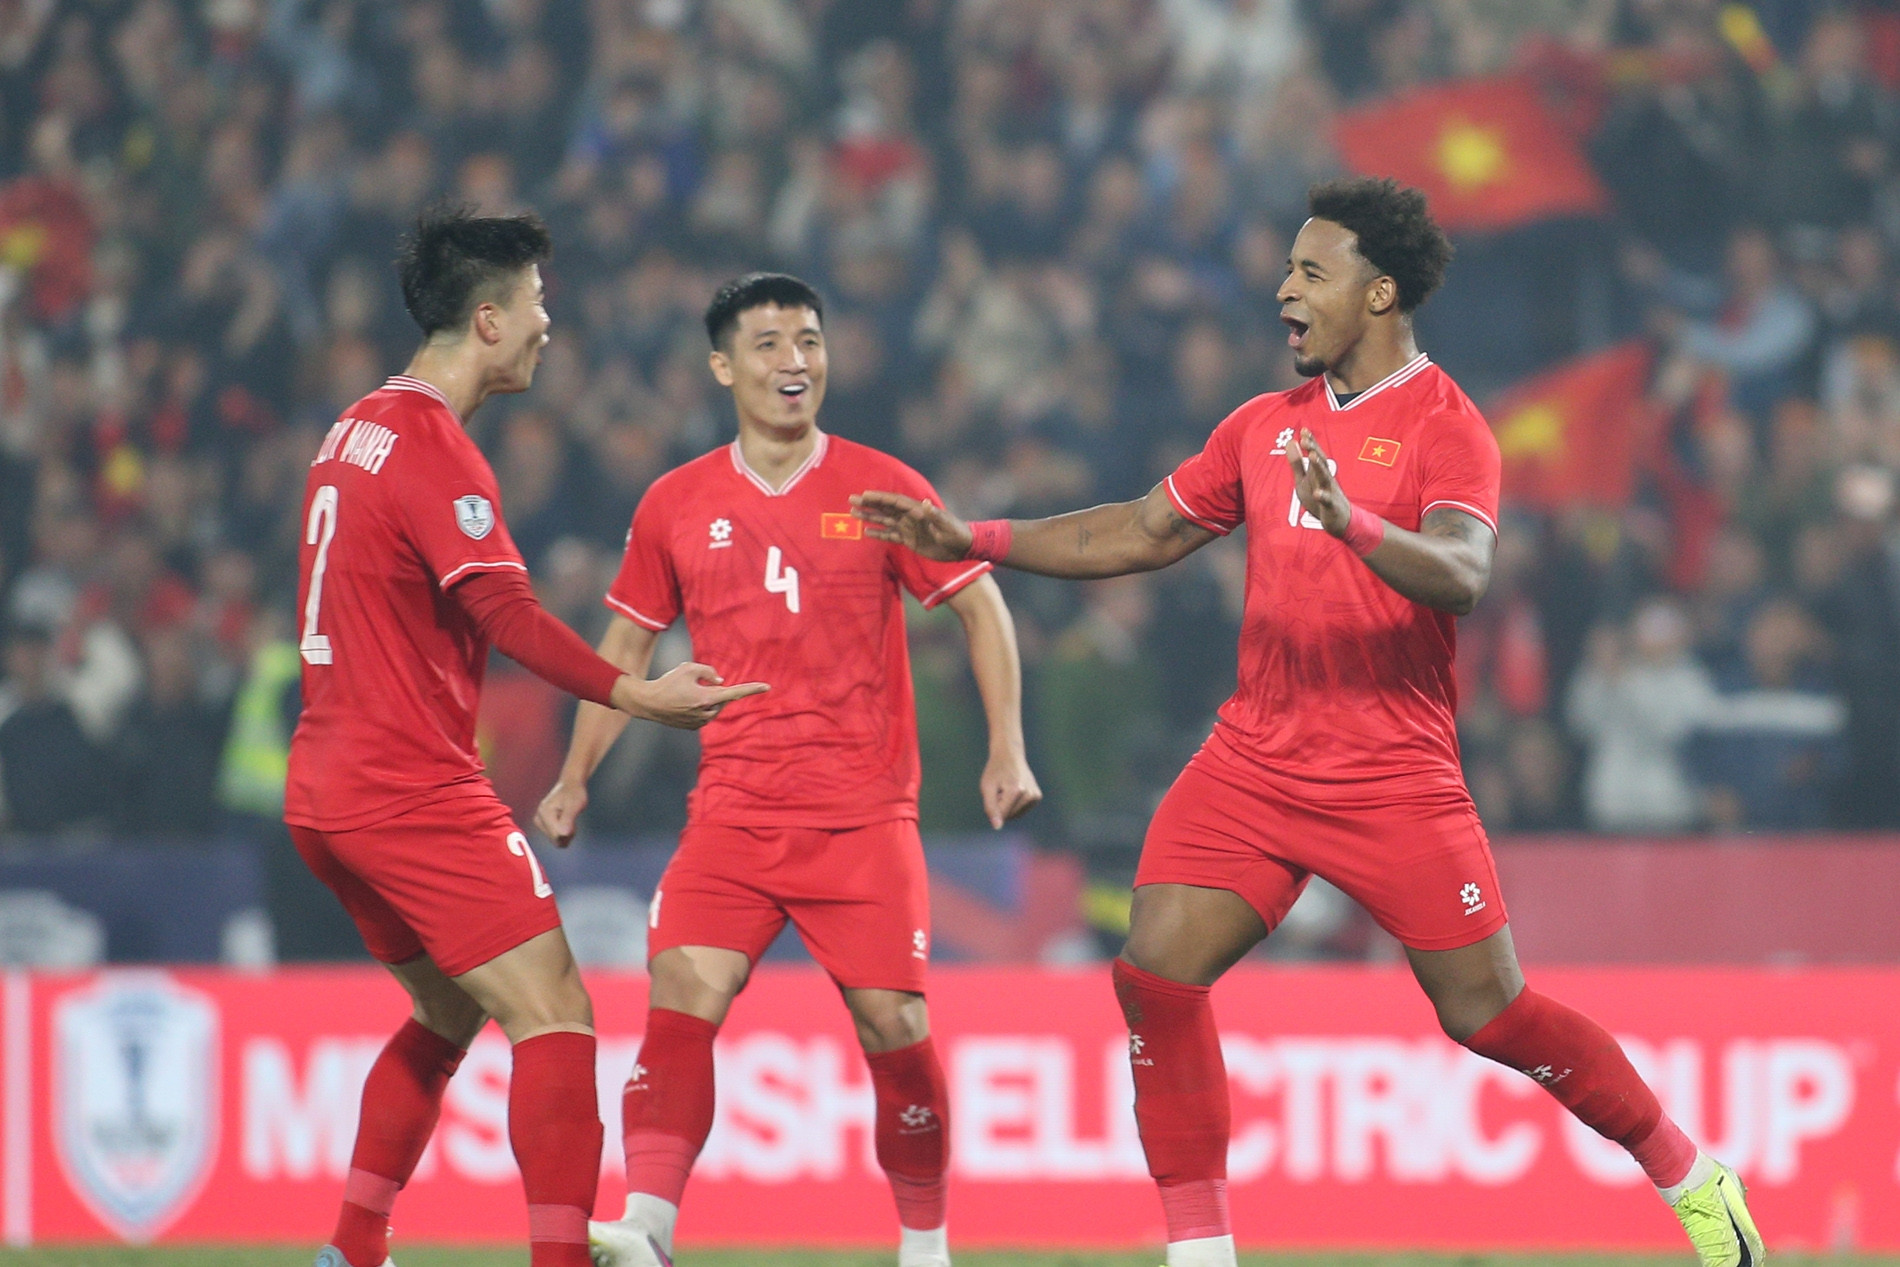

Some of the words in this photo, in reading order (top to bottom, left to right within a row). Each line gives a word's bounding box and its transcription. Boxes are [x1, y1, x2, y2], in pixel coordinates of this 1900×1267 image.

[300, 485, 338, 665] 2
[764, 545, 800, 614] 4
[506, 831, 553, 899] 2
